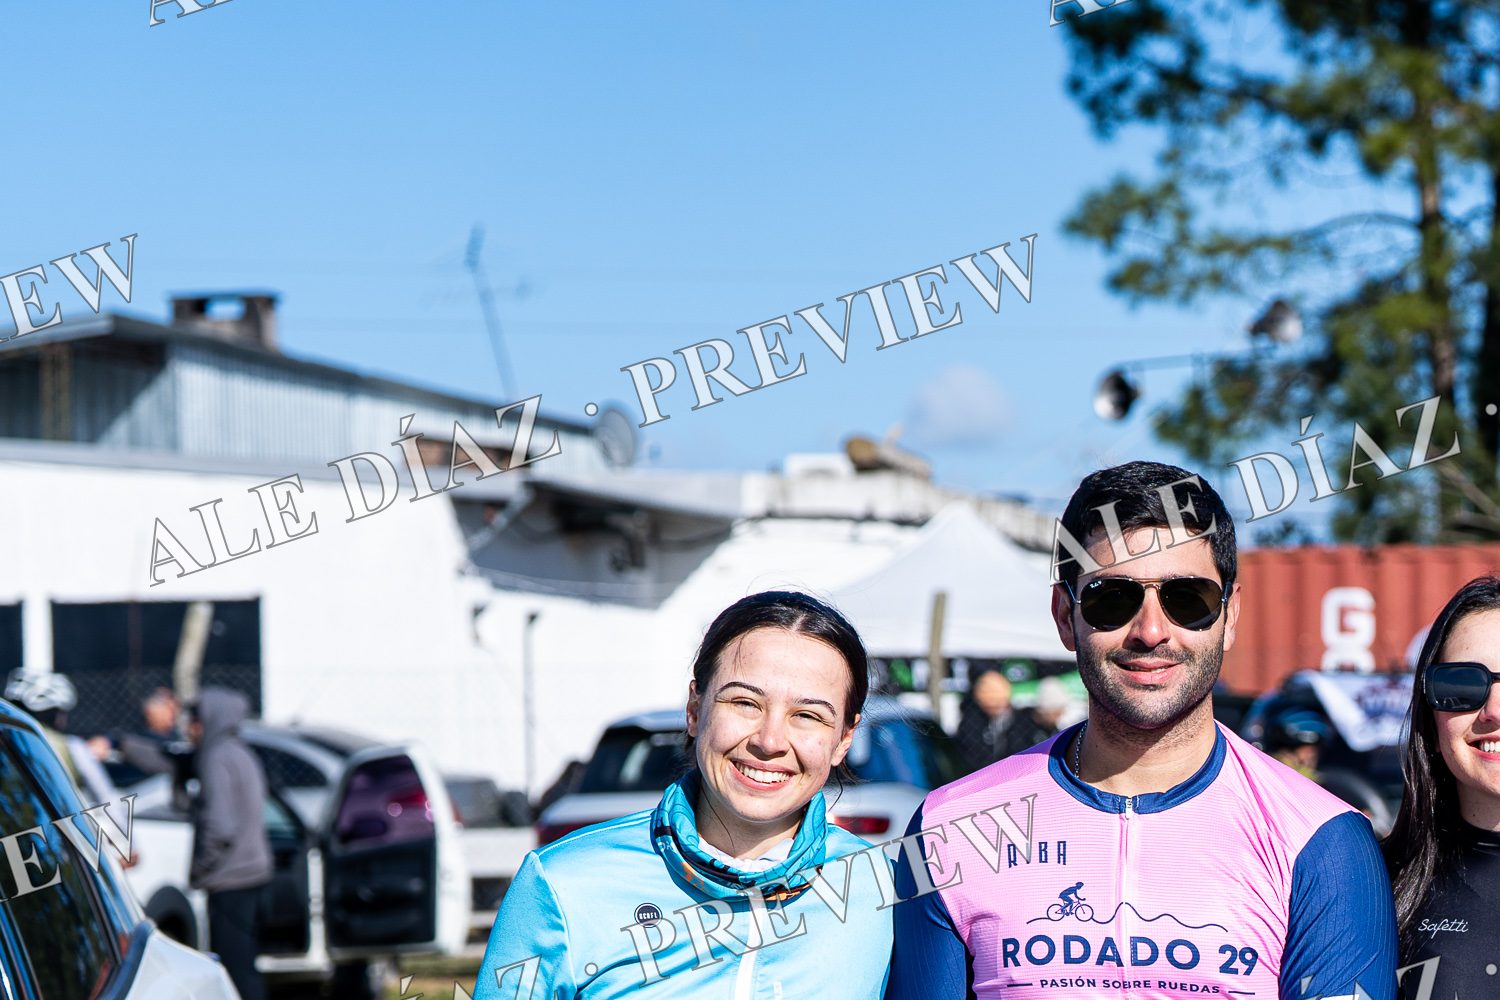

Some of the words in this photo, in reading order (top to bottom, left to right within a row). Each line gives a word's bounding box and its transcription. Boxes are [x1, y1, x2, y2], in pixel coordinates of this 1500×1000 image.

[1418, 918, 1469, 940] Safetti
[1002, 934, 1200, 970] RODADO
[1218, 944, 1259, 976] 29
[1040, 976, 1097, 989] PASIÓN
[1102, 979, 1151, 989] SOBRE
[1158, 980, 1220, 994] RUEDAS
